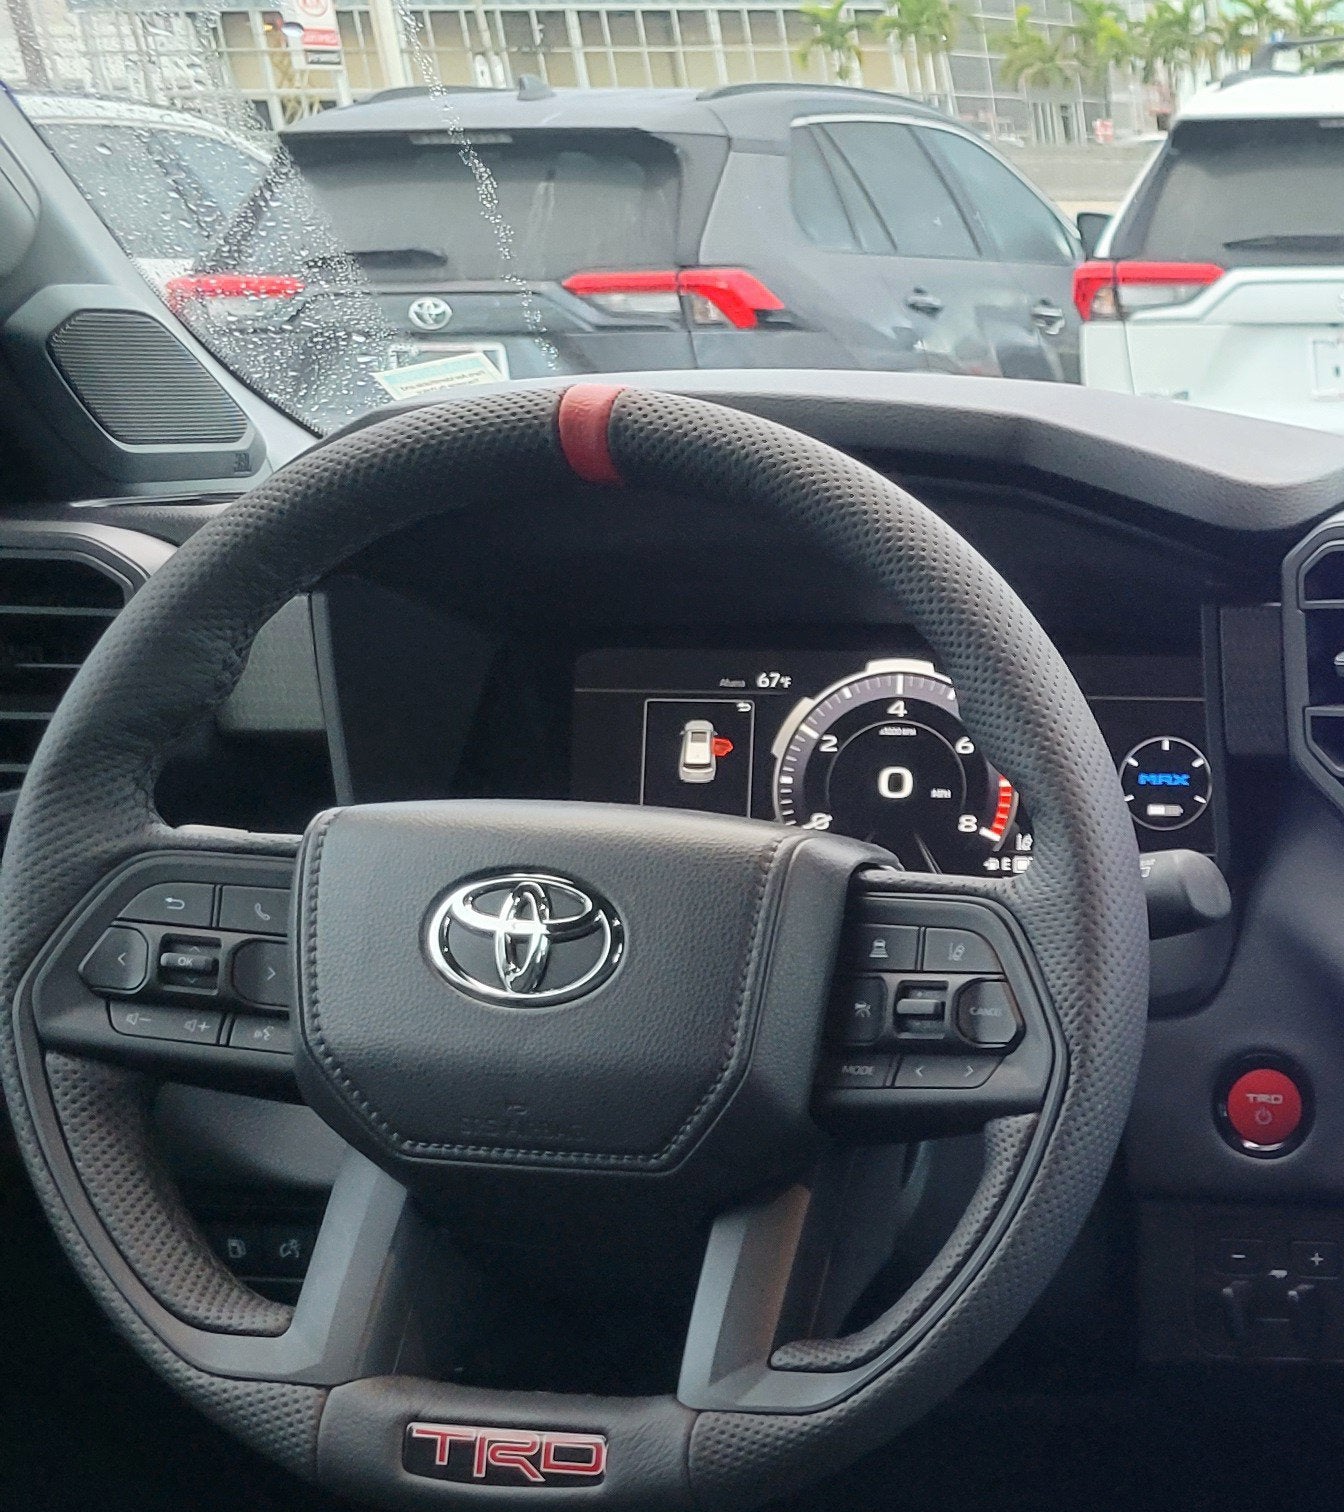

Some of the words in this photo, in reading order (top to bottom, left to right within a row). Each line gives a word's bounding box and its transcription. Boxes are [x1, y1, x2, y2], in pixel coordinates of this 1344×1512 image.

[887, 701, 908, 718] 4
[818, 735, 838, 753] 2
[955, 737, 975, 754] 6
[878, 767, 914, 799] 0
[1137, 772, 1190, 787] MAX
[958, 815, 978, 833] 8
[177, 956, 194, 966] OK
[1245, 1093, 1284, 1105] TRD
[411, 1422, 607, 1483] TRD
